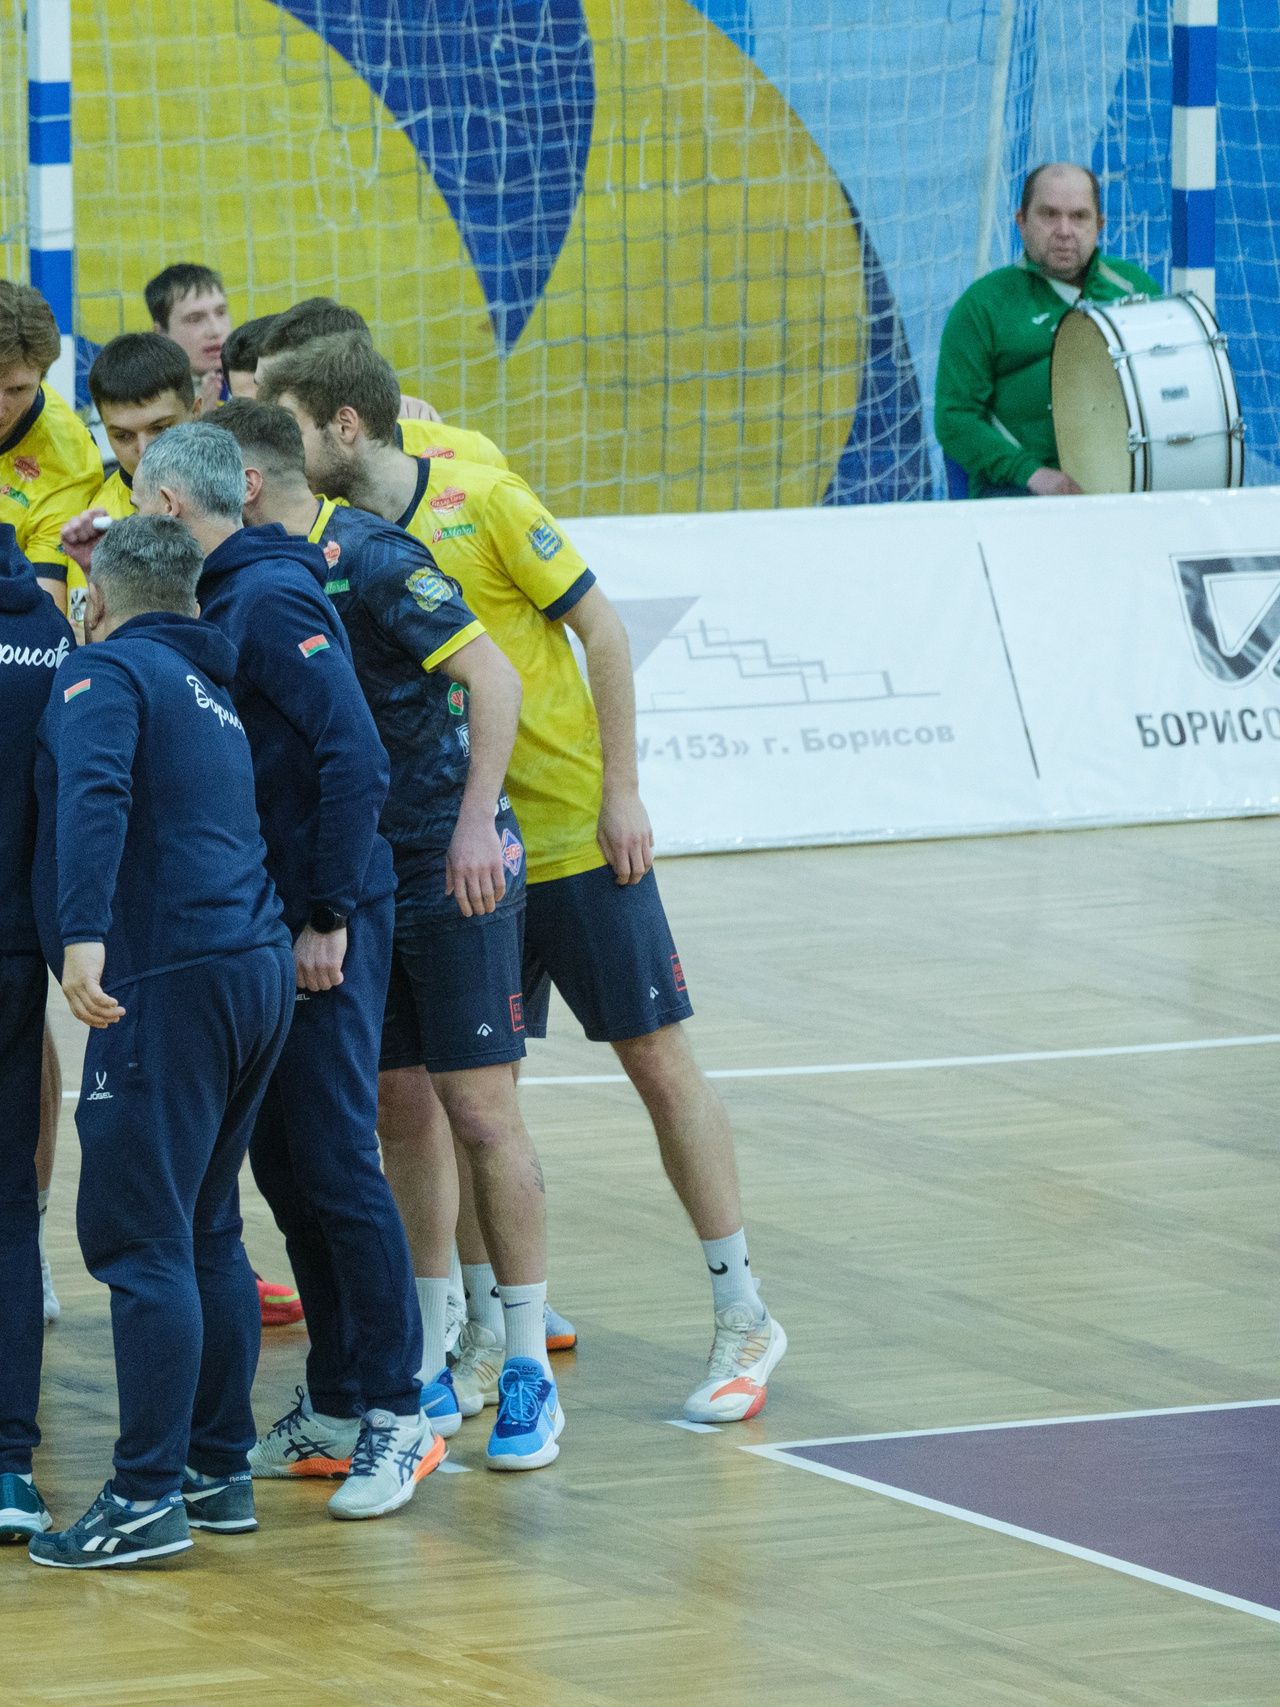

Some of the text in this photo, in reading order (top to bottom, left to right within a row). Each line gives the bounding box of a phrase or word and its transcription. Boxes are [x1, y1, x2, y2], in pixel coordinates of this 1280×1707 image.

[186, 674, 246, 735] Борис
[800, 724, 956, 754] Борисов
[1135, 708, 1280, 749] БОРИСО
